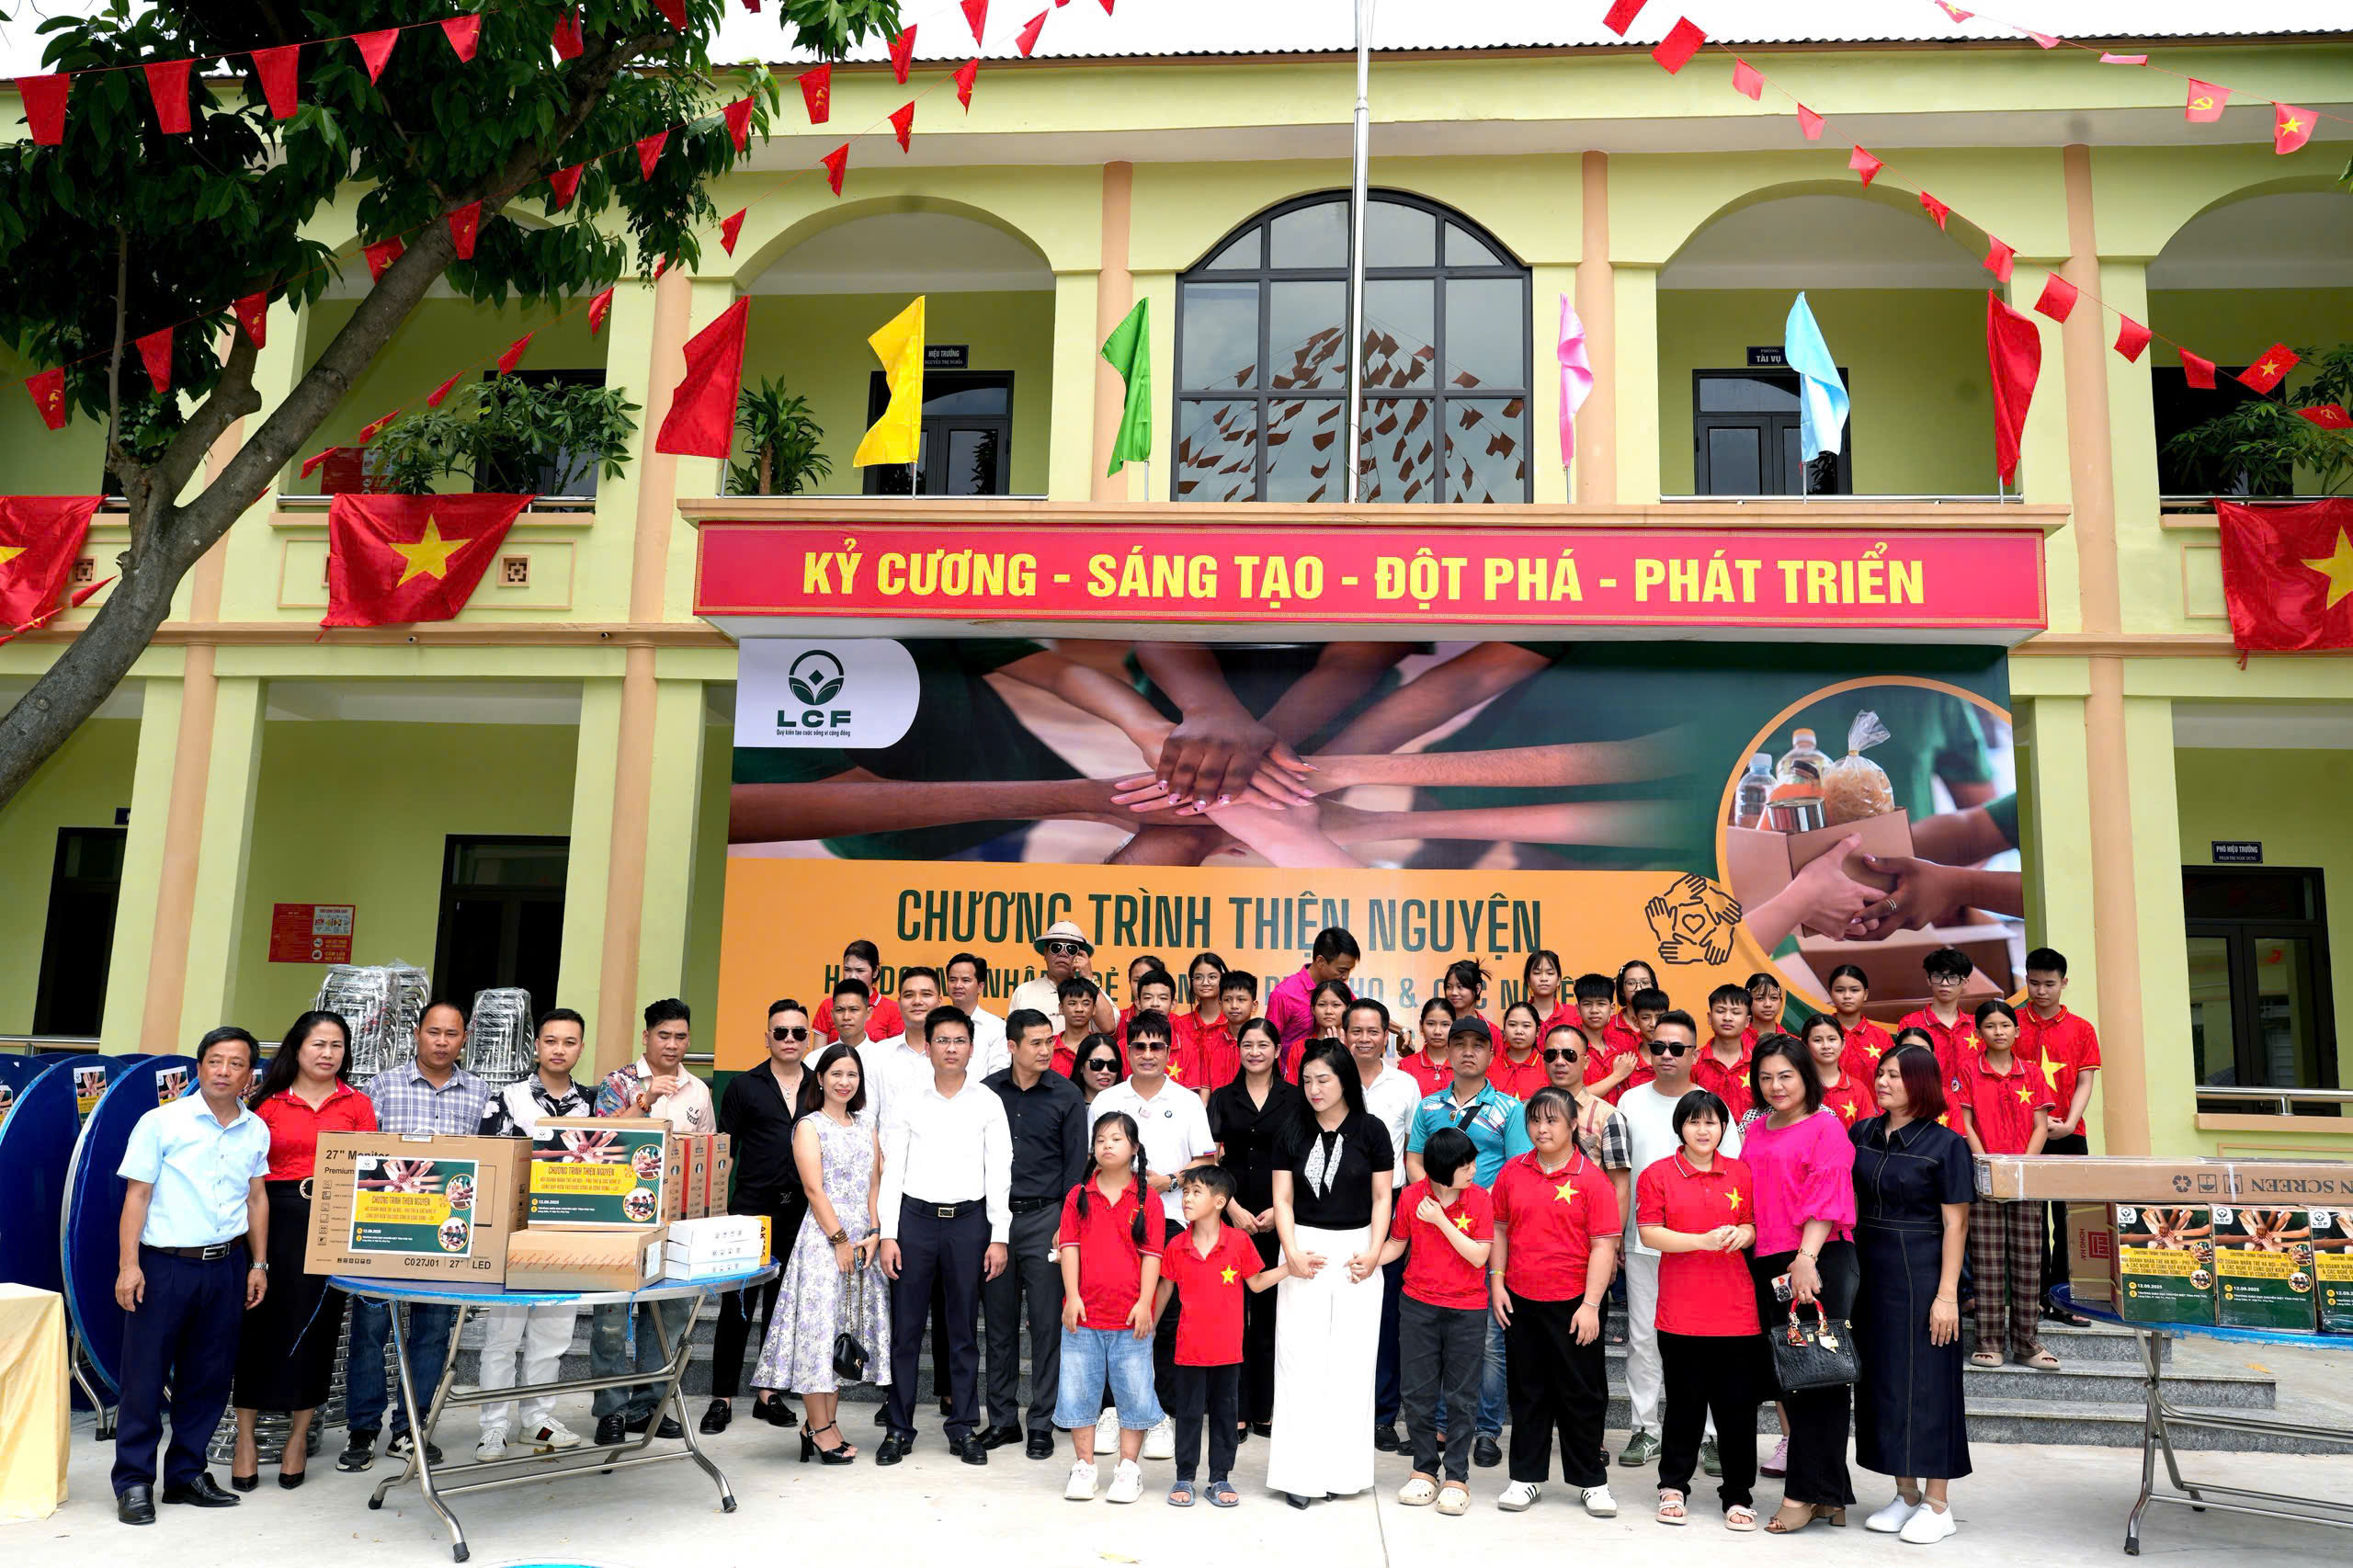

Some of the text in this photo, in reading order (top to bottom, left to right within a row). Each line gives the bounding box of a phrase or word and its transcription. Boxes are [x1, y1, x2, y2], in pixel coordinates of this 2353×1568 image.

[1756, 354, 1781, 364] TÀI VỤ
[803, 537, 1925, 610] KỶ CƯƠNG - SÁNG TẠO - ĐỘT PHÁ - PHÁT TRIỂN
[777, 710, 851, 728] LCF
[898, 887, 1541, 960] CHƯƠNG TRÌNH THIỆN NGUYỆN
[983, 966, 1048, 998] NHÂ
[1399, 977, 1418, 1008] &
[326, 1150, 344, 1159] 27"
[2251, 1178, 2334, 1193] SCREEN
[472, 1261, 491, 1269] LED
